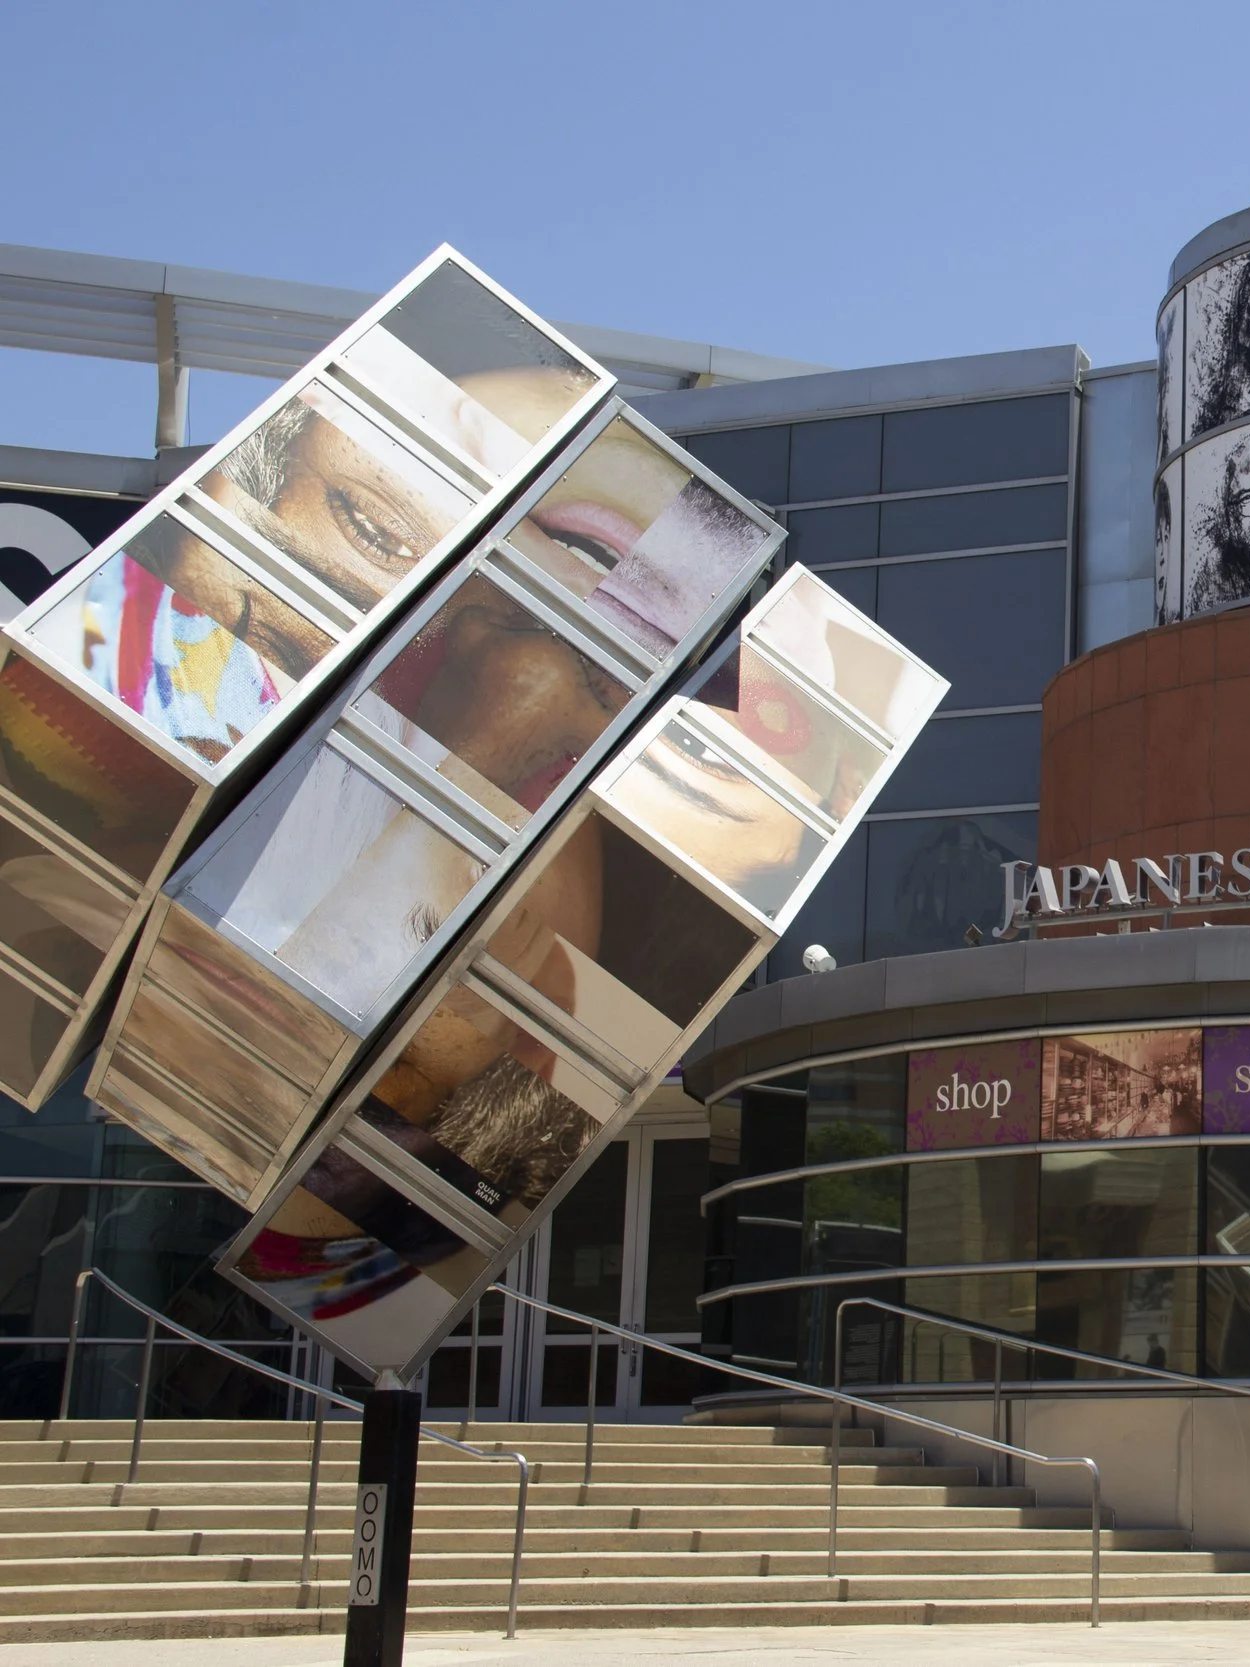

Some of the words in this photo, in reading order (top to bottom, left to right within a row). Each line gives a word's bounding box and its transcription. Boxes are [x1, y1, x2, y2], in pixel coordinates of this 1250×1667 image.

[936, 1072, 1012, 1119] shop
[475, 1188, 495, 1206] MAN
[477, 1181, 500, 1201] QUAIL
[356, 1491, 378, 1597] OOMO
